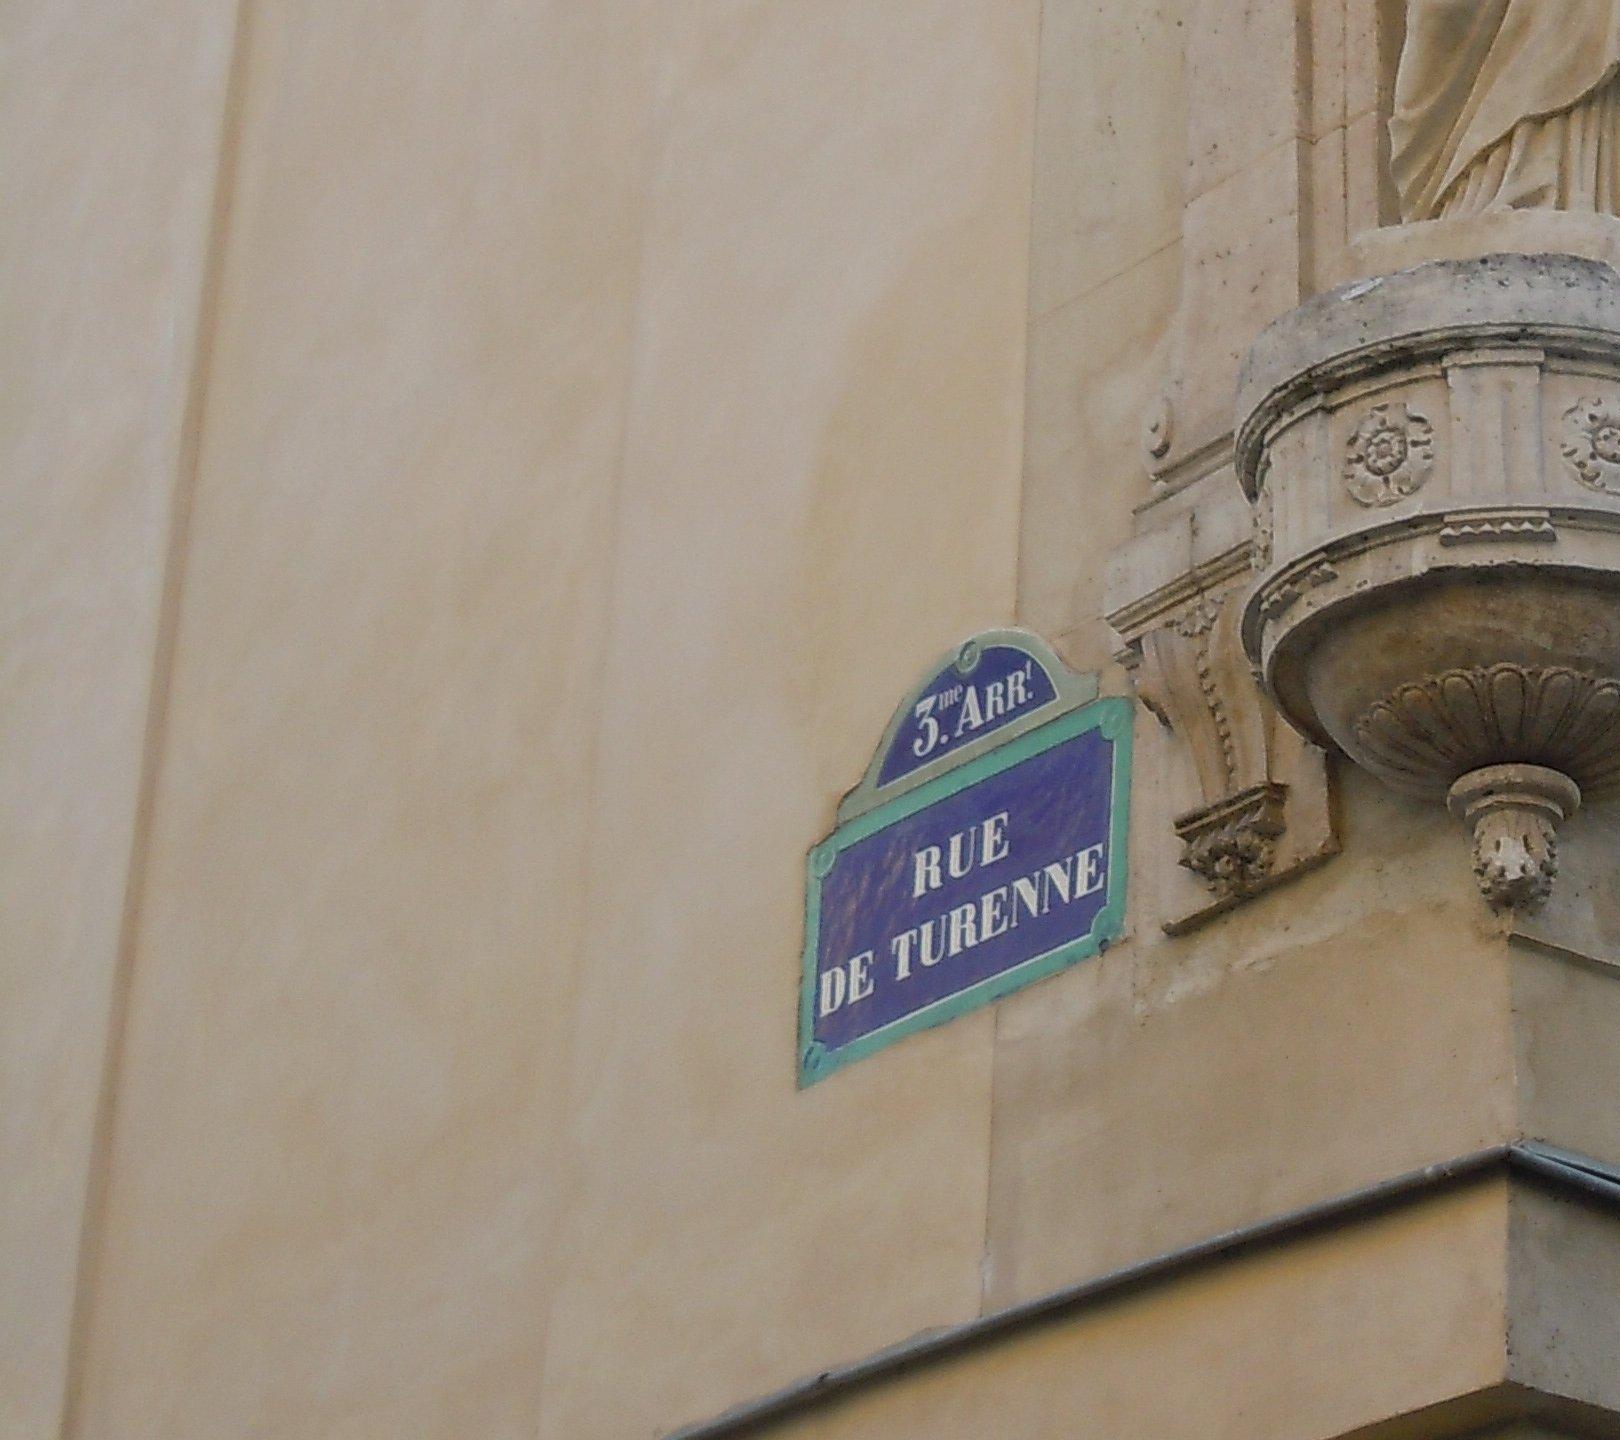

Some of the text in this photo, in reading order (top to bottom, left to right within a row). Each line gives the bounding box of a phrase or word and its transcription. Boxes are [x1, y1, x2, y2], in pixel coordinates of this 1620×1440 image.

[913, 812, 1008, 898] RUE
[820, 843, 1105, 1017] DE TURENNE
